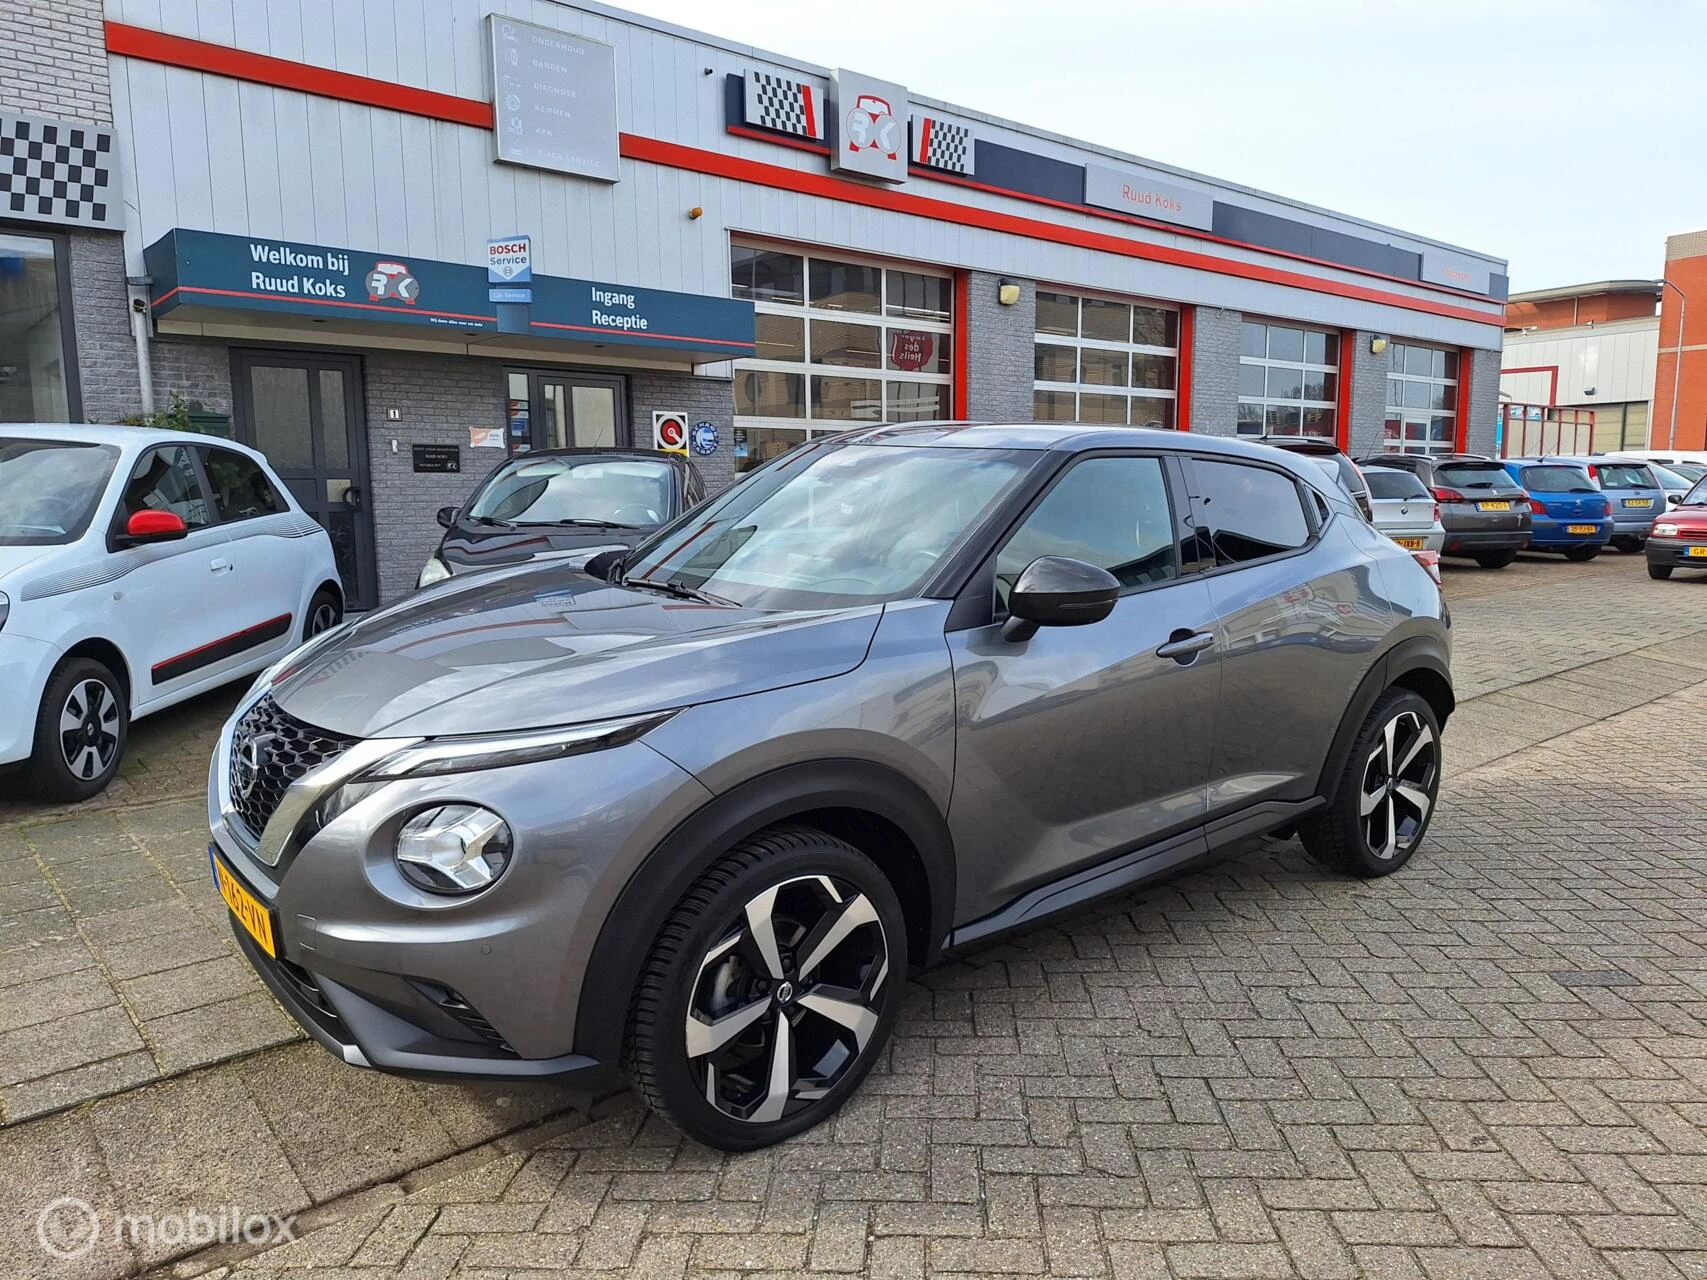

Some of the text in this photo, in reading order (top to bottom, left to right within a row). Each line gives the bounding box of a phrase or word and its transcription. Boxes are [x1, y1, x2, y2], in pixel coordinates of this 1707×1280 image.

[532, 36, 585, 55] ONDERHOUD
[532, 59, 568, 73] BANDEN
[533, 82, 577, 98] DIAGNOSE
[534, 104, 571, 119] REMMEN
[1122, 184, 1152, 205] Ruud
[490, 243, 526, 255] BOSCH
[250, 243, 349, 276] Welkom bij
[490, 255, 527, 265] Service
[251, 271, 346, 298] Ruud Koks
[591, 286, 636, 309] Ingang
[591, 309, 648, 331] Receptie
